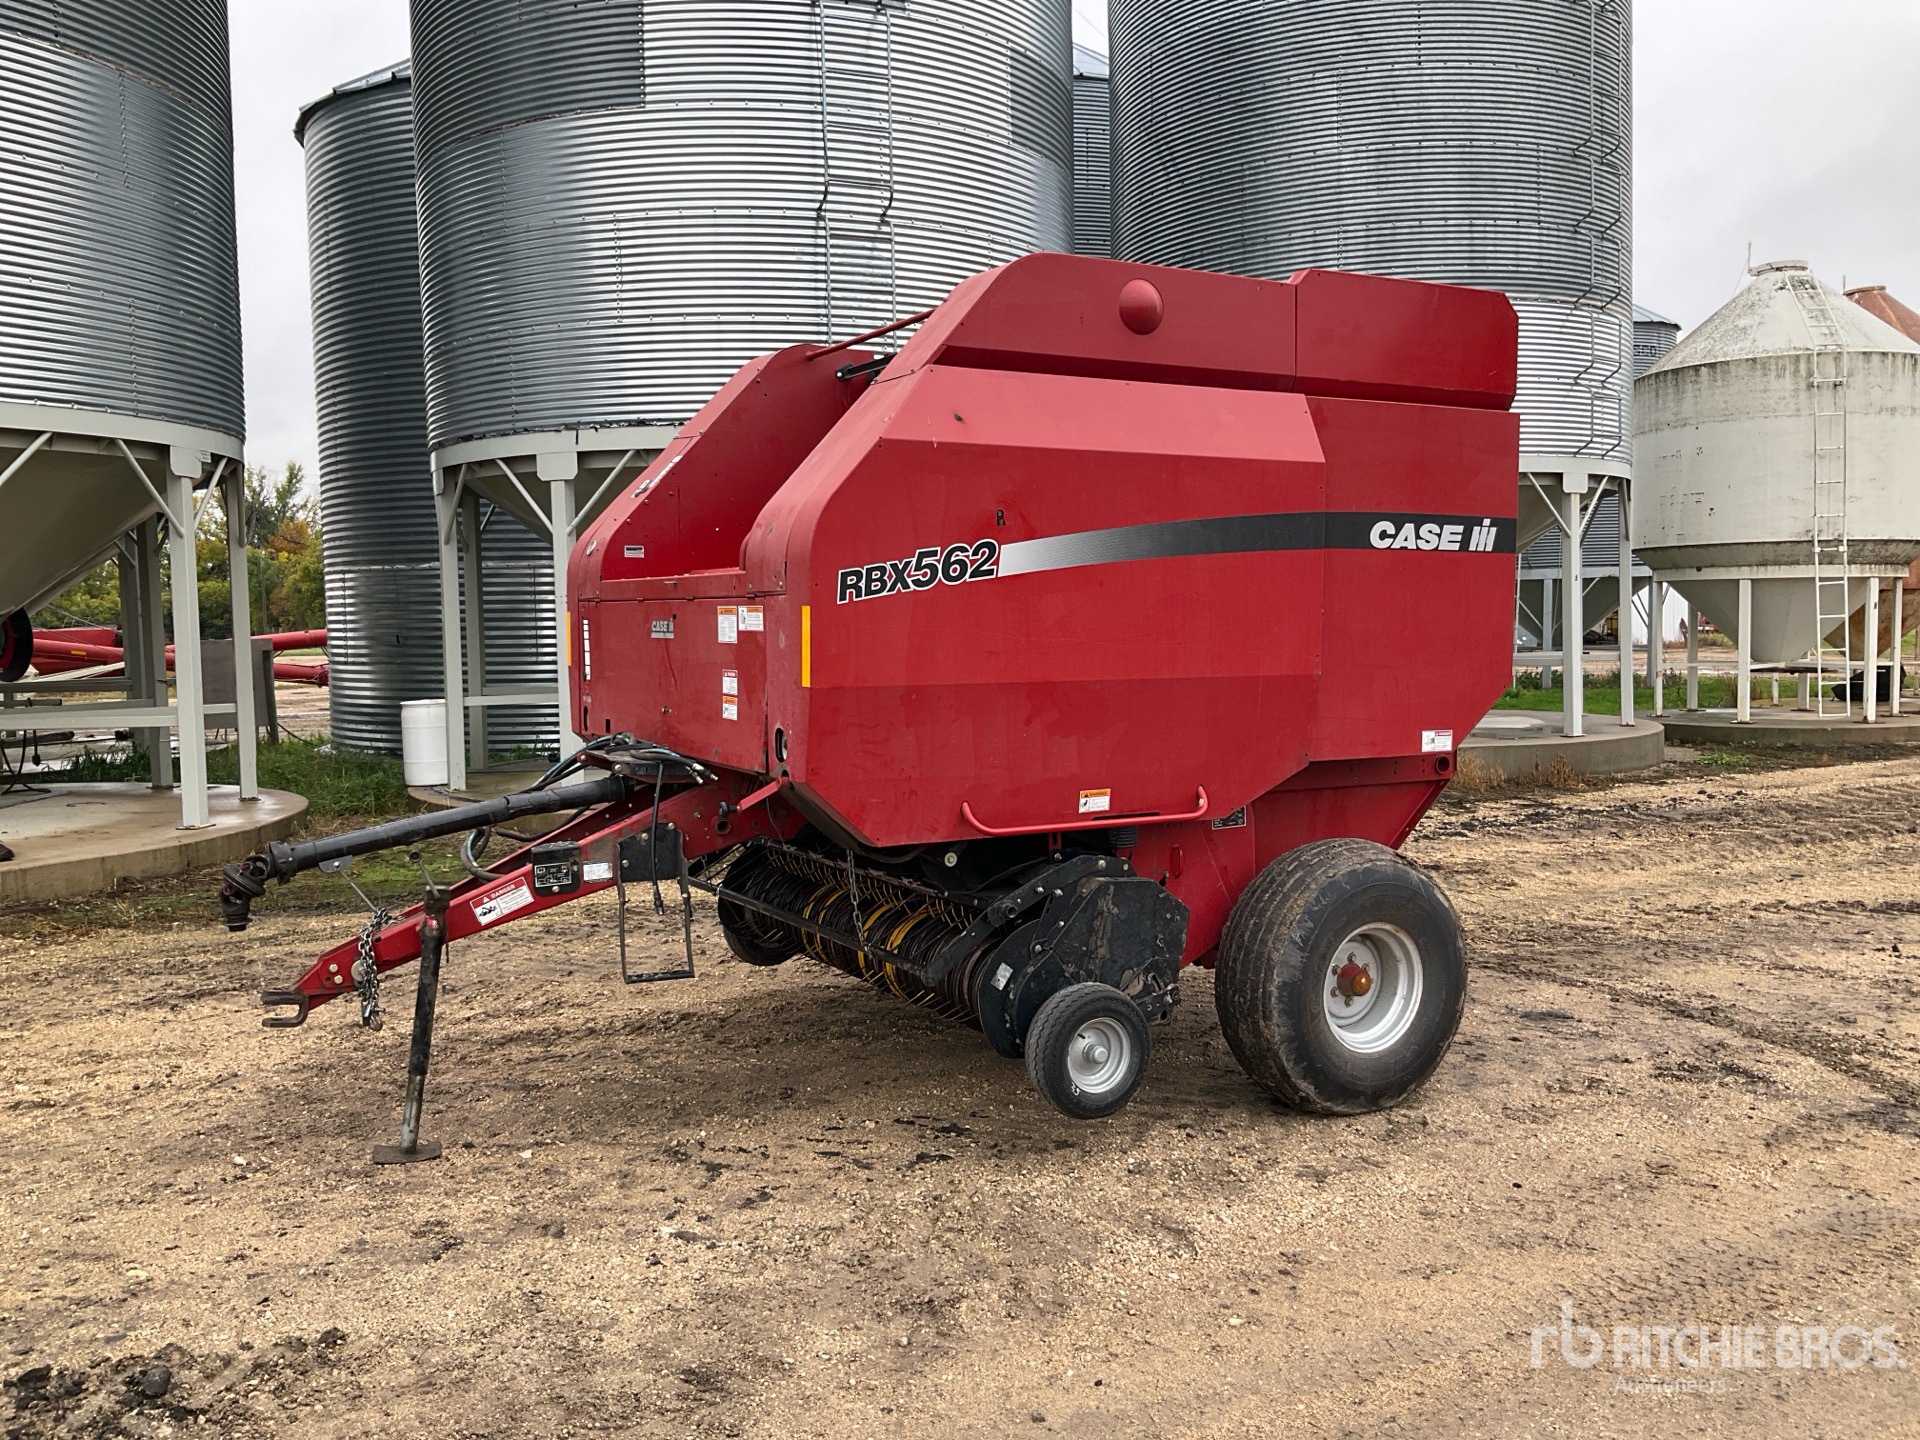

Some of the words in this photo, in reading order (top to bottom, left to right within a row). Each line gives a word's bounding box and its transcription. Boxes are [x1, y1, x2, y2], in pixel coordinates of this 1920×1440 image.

[1369, 520, 1465, 551] CASE
[837, 539, 998, 605] RBX562
[652, 620, 668, 632] CASE
[490, 884, 516, 899] DANGER
